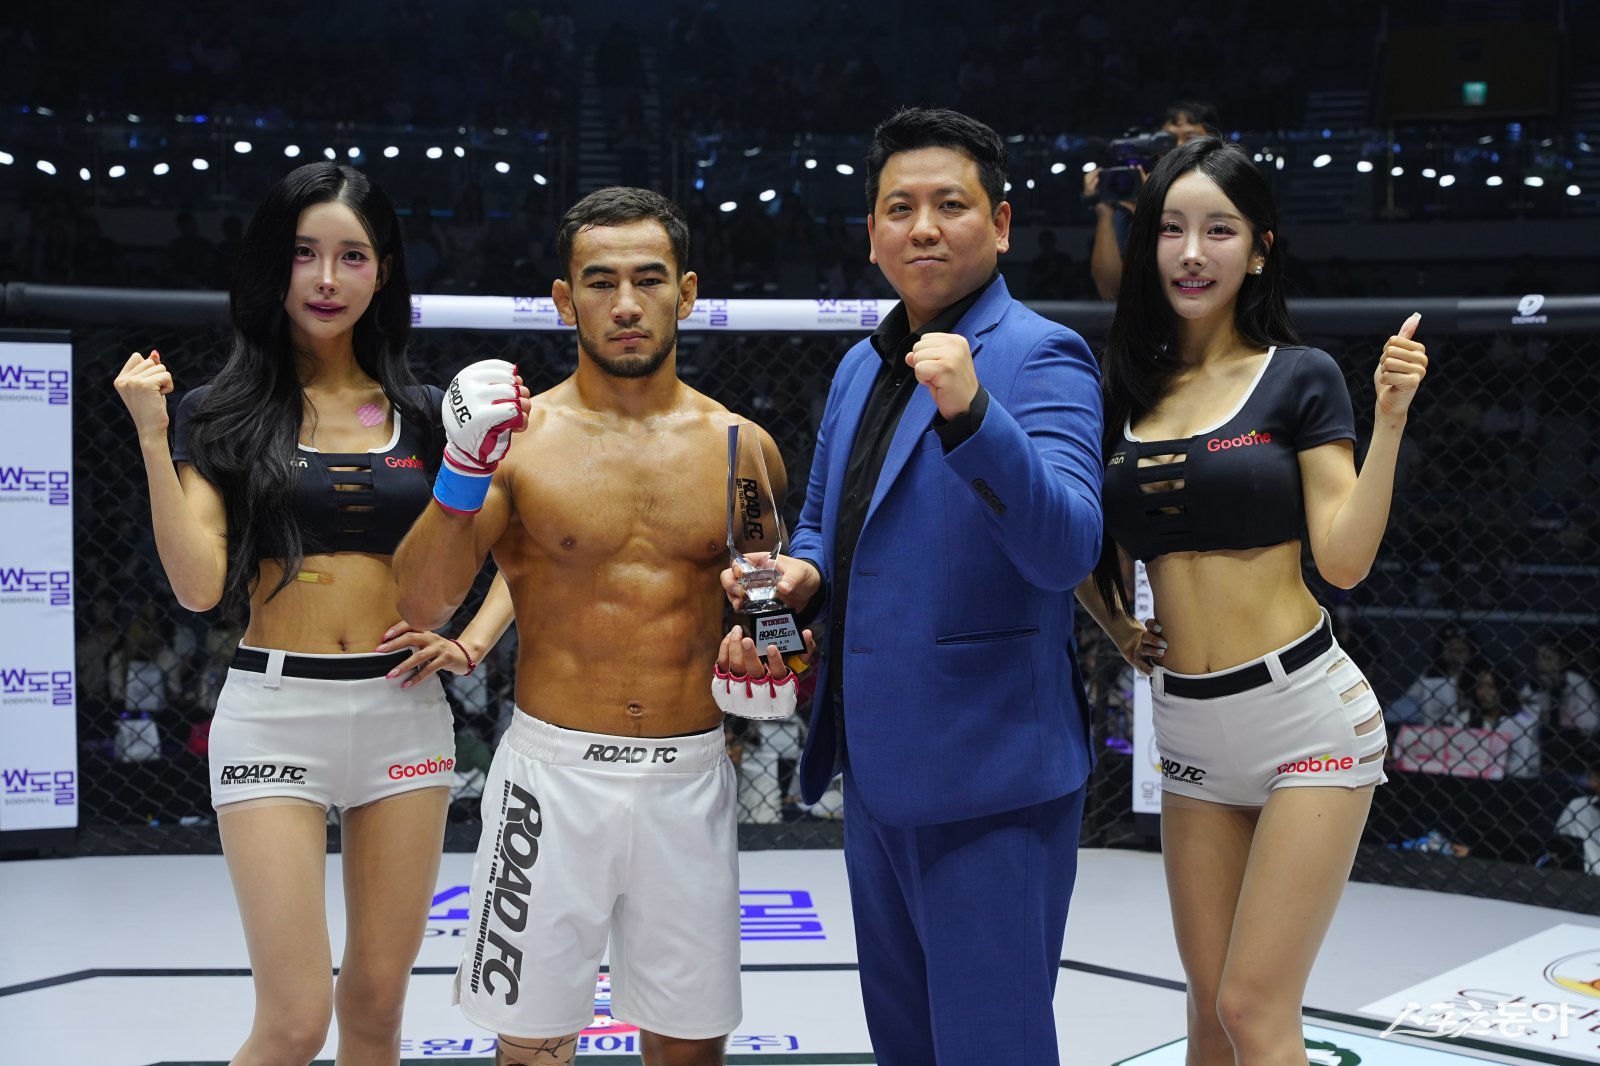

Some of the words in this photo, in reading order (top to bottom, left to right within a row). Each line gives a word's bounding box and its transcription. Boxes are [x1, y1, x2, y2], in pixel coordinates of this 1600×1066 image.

[456, 405, 472, 424] FC
[742, 477, 762, 519] ROAD
[747, 521, 764, 540] FC
[582, 743, 648, 764] ROAD
[651, 747, 678, 764] FC
[221, 765, 277, 780] ROAD
[279, 765, 308, 781] FC
[1180, 765, 1207, 781] FC
[493, 782, 543, 934] ROAD
[471, 889, 493, 995] CHAMPIONSHIP
[481, 928, 524, 1006] FC
